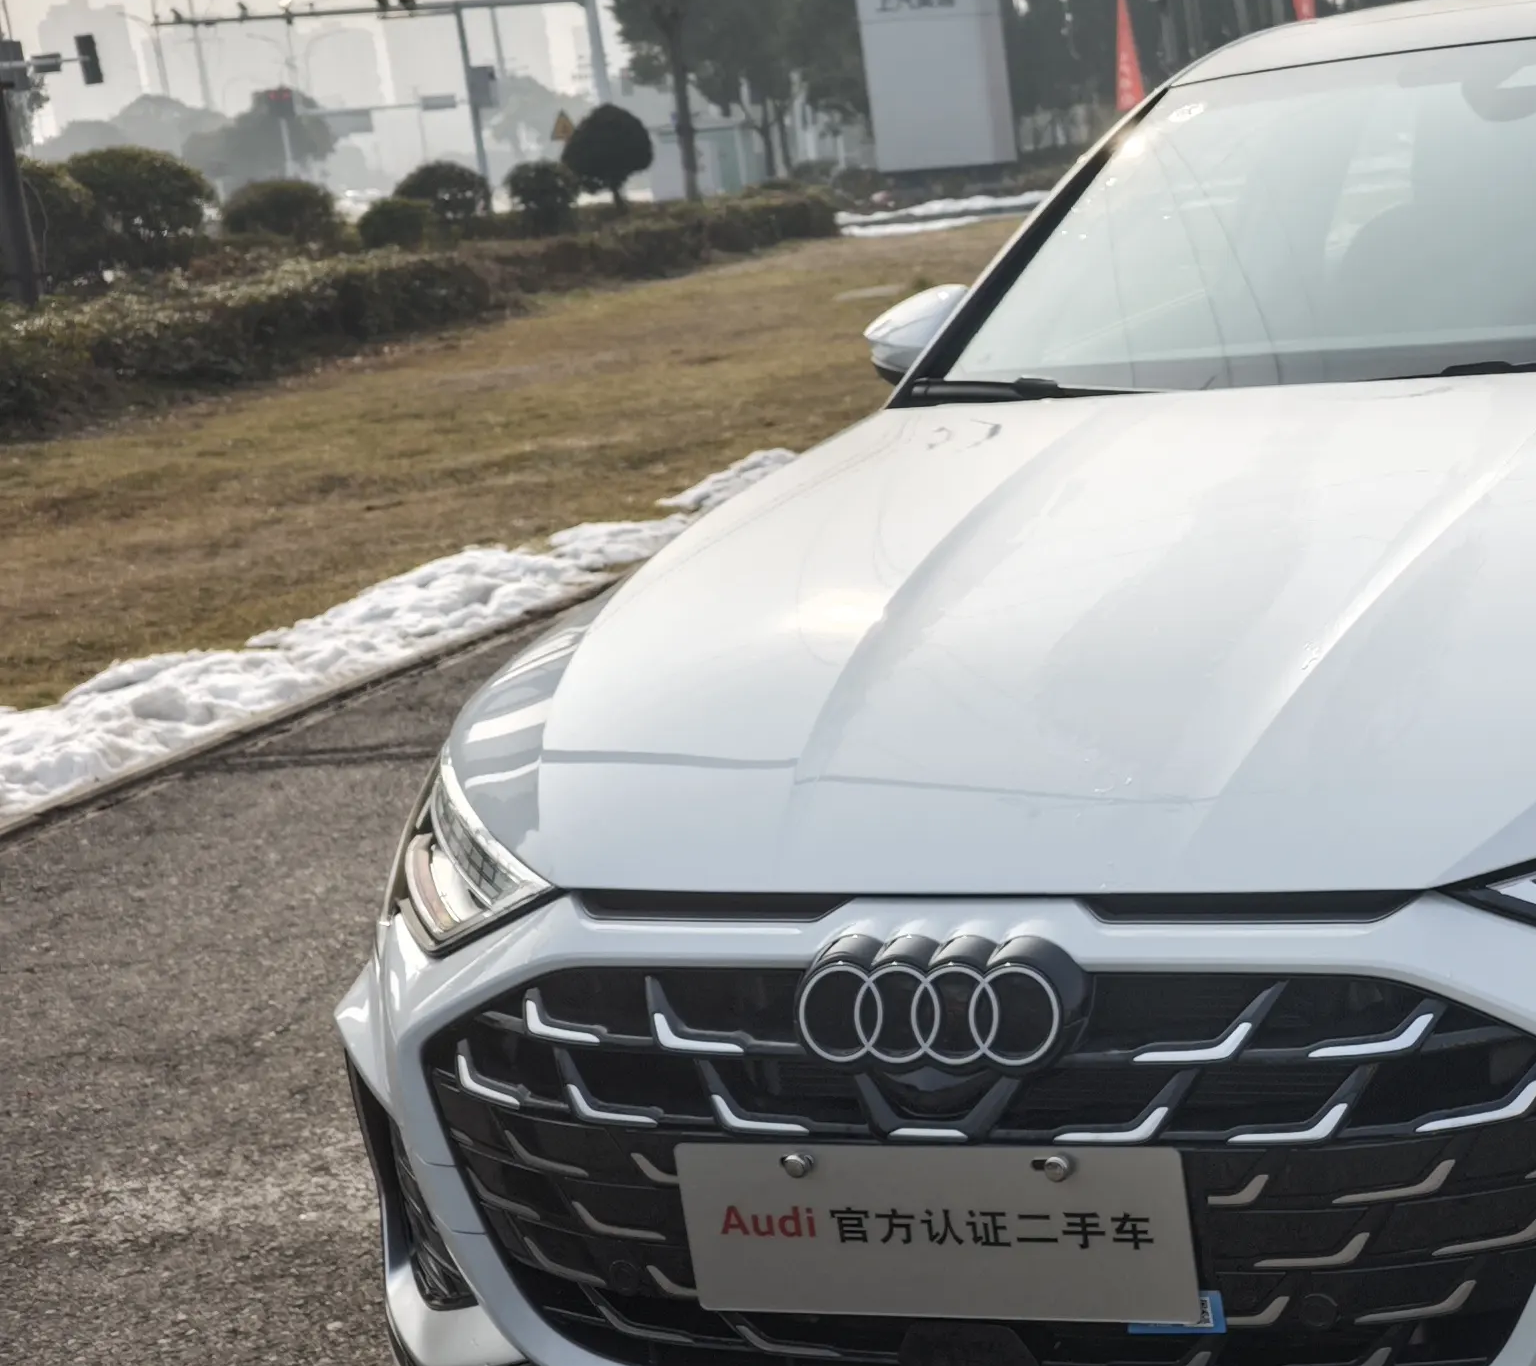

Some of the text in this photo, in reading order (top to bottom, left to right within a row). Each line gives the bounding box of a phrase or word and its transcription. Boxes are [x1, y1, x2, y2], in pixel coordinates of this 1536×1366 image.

[720, 1206, 1155, 1250] Audi 官方认证二手车
